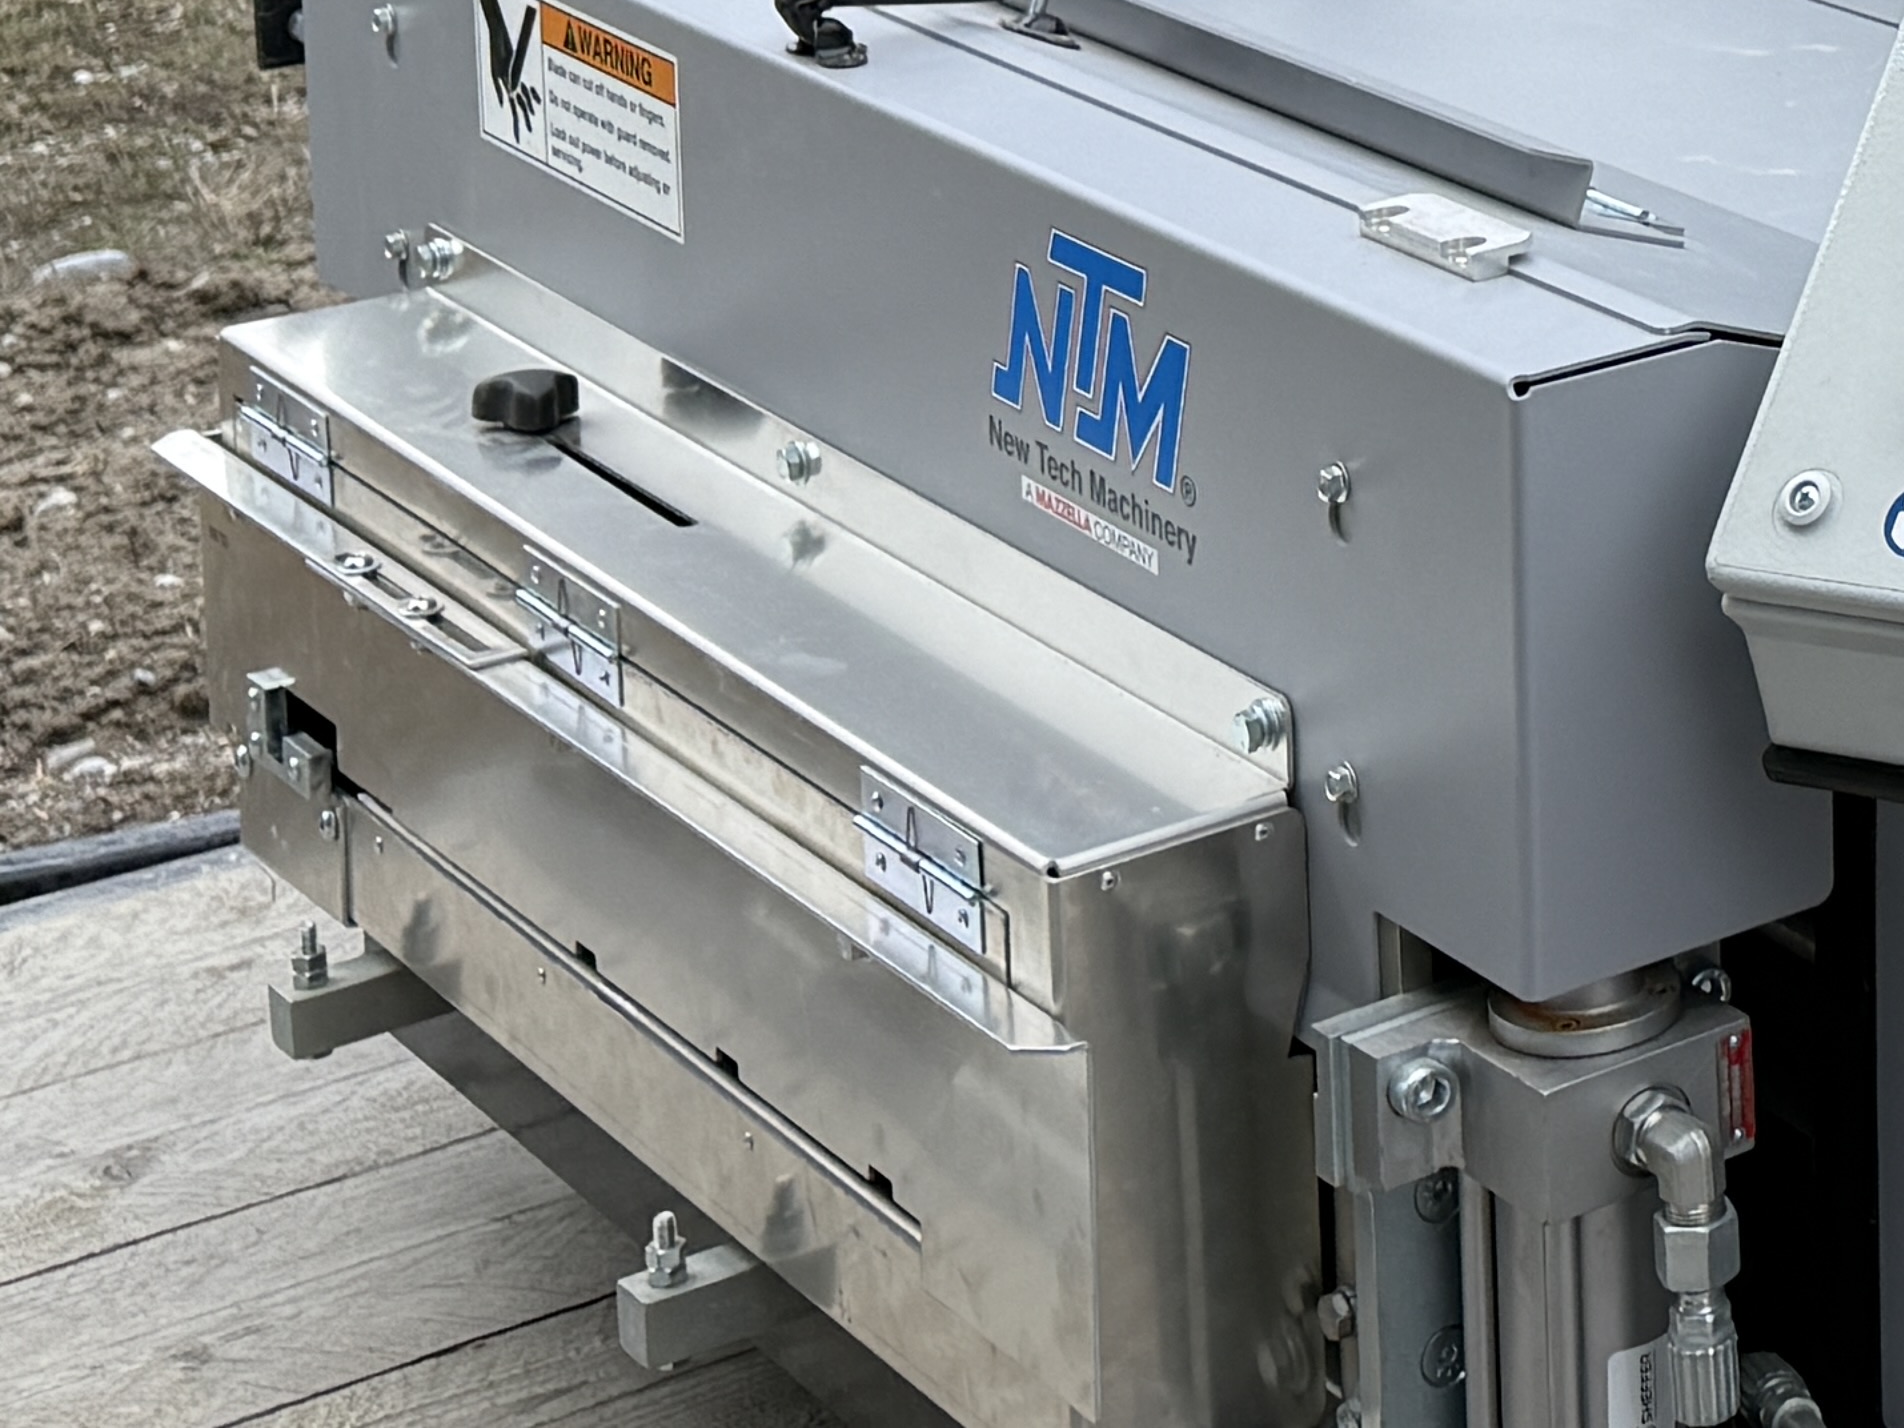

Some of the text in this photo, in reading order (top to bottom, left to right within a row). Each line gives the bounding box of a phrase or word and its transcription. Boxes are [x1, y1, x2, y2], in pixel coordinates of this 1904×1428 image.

[577, 24, 653, 88] WARNING
[991, 228, 1190, 493] NTM
[988, 414, 1197, 565] New Tech Machinery
[1024, 483, 1033, 498] A
[1093, 520, 1155, 569] COMPANY
[1640, 1352, 1653, 1424] SHEFFER
